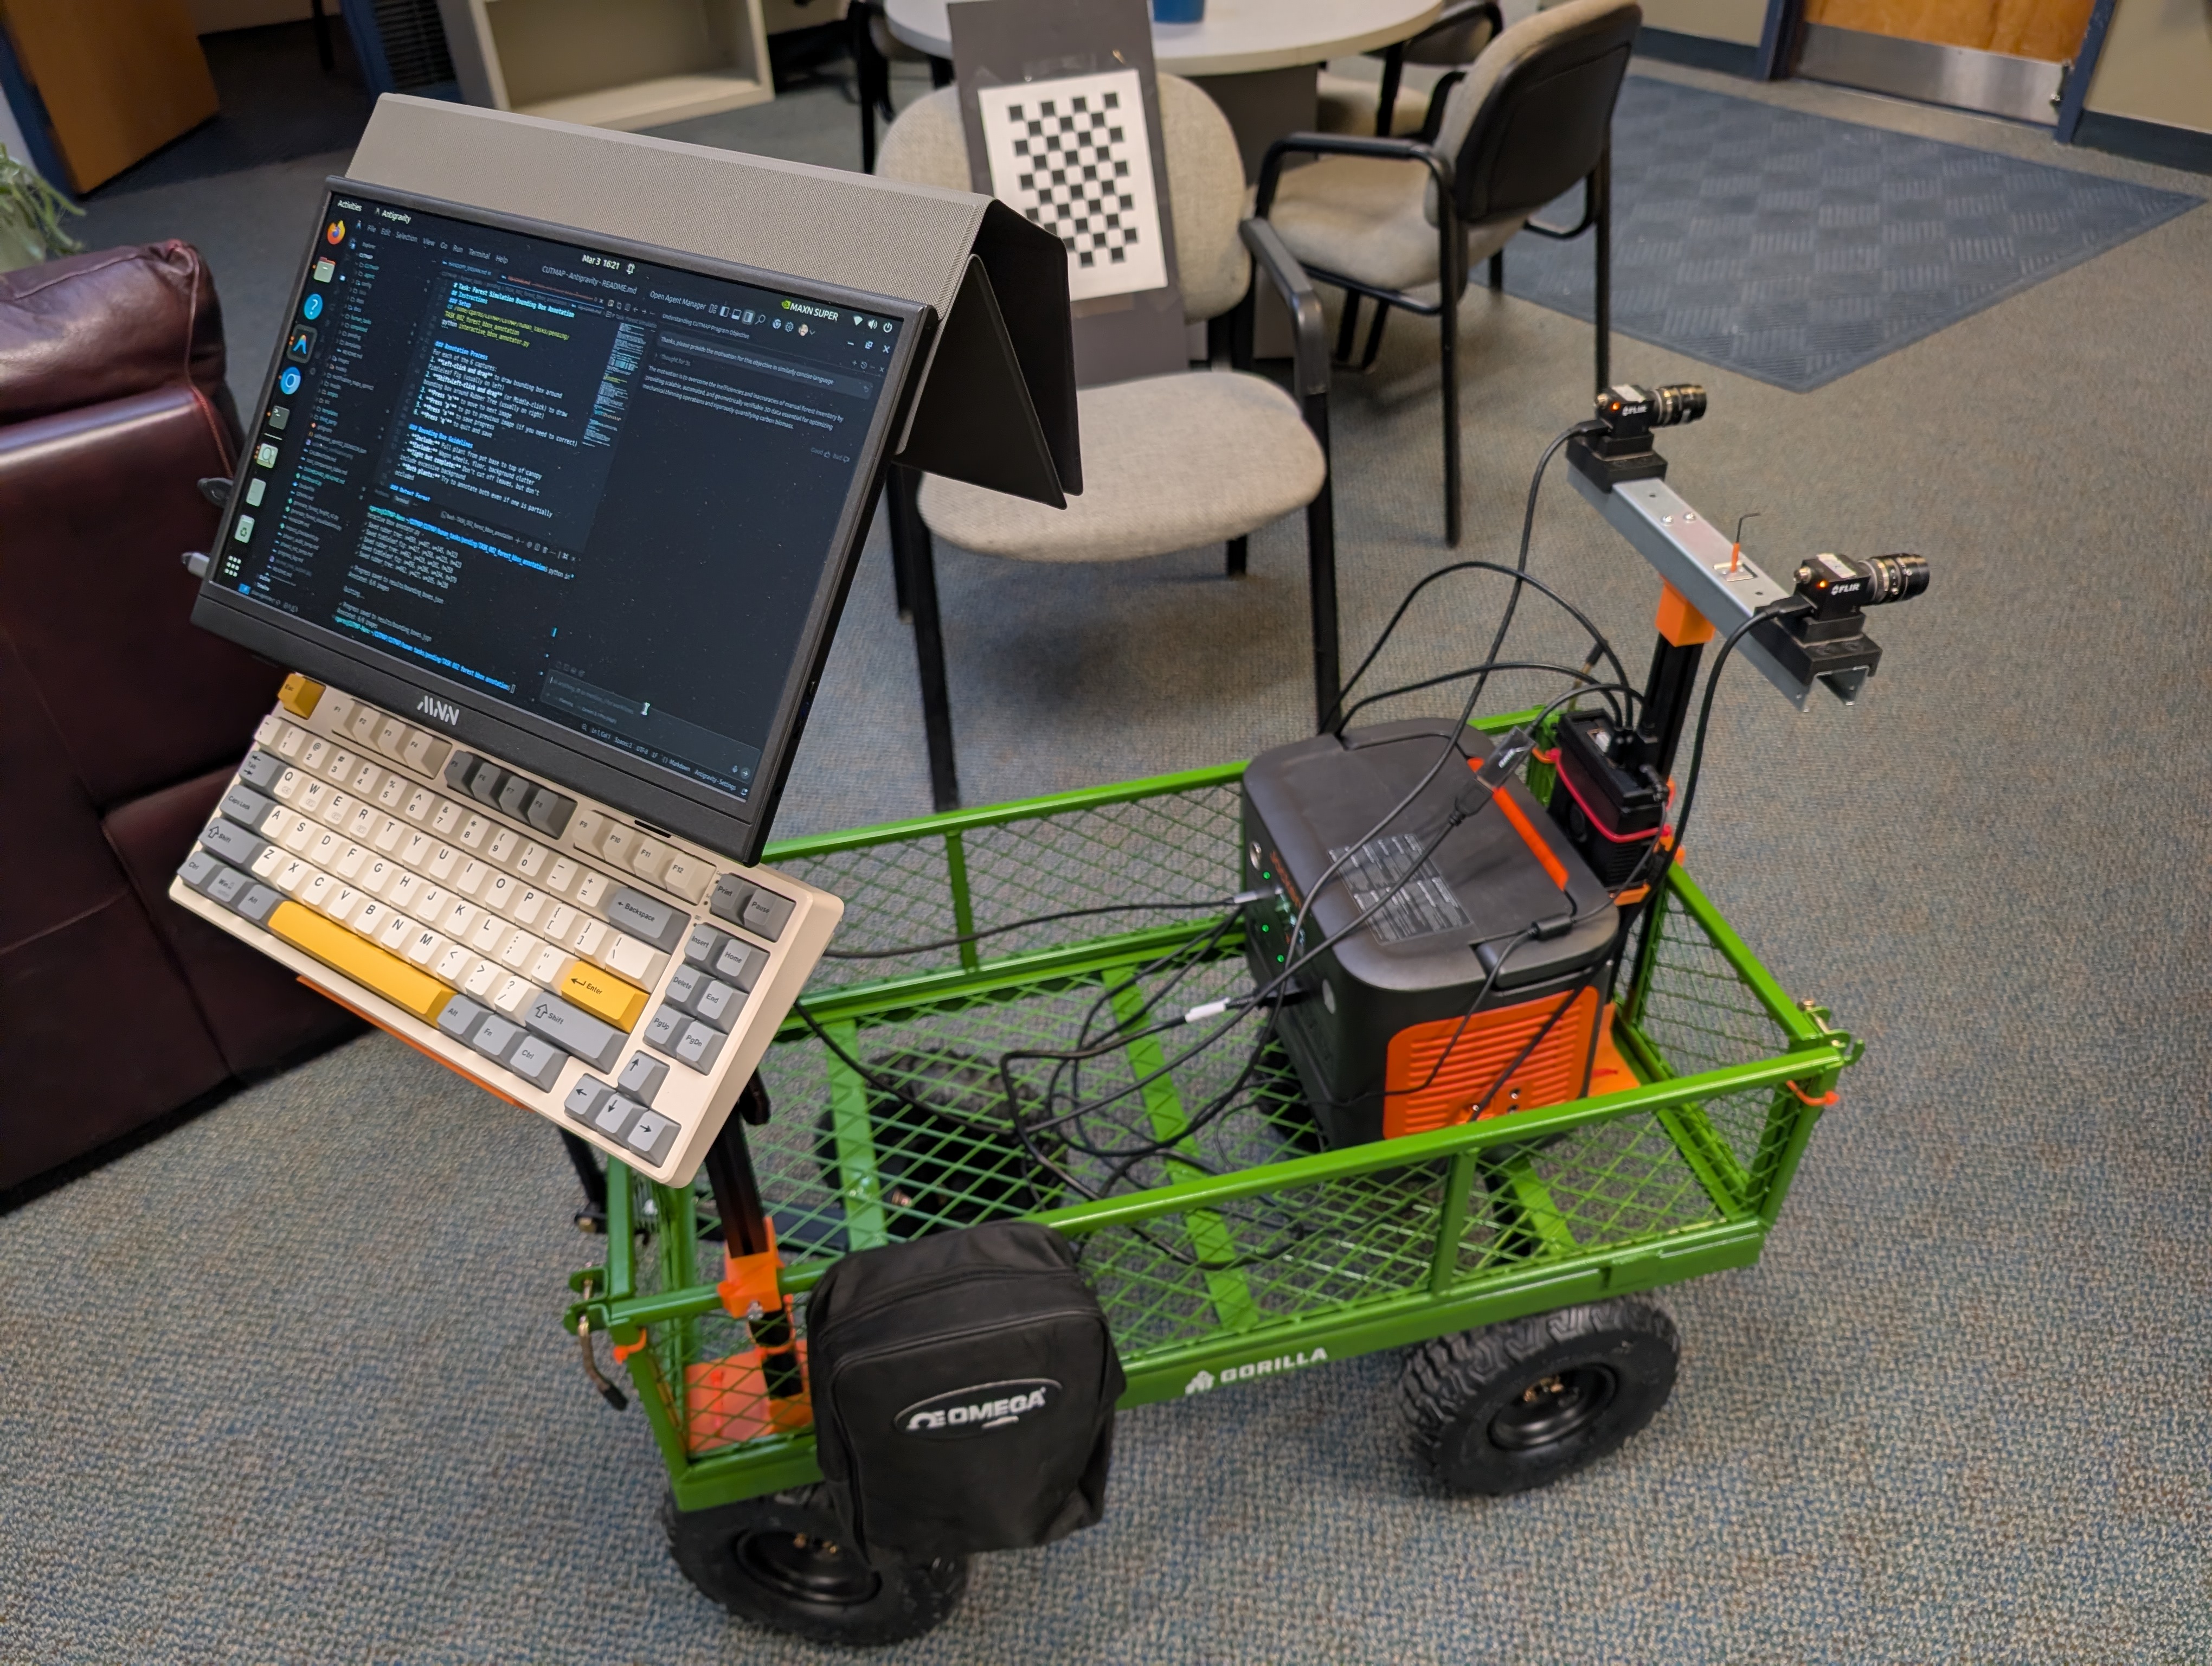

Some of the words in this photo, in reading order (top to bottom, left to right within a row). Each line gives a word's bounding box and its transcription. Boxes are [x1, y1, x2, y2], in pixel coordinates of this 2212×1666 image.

[338, 200, 362, 211] Activities
[381, 210, 411, 223] Antigravity
[395, 232, 418, 242] Selection
[468, 248, 491, 259] Terminal
[495, 255, 509, 264] Help
[582, 255, 596, 264] Mar
[602, 259, 620, 269] 16:21
[542, 266, 565, 277] CUTMAP
[568, 273, 599, 286] Antigravity
[602, 280, 637, 294] README.md
[472, 287, 488, 296] Forest
[488, 291, 515, 302] Simulation
[649, 291, 665, 301] Open
[665, 295, 681, 305] Agent
[681, 299, 706, 311] Manager
[790, 304, 813, 314] MAXN
[814, 309, 838, 321] SUPER
[555, 435, 577, 447] correct)
[528, 505, 552, 517] partially
[1838, 582, 1861, 593] FLIR
[285, 772, 293, 781] Q
[309, 783, 320, 794] W
[228, 795, 240, 804] Caps
[333, 796, 343, 806] E
[272, 810, 281, 821] A
[358, 809, 368, 819] R
[297, 822, 306, 832] S
[386, 822, 395, 832] T
[218, 832, 232, 844] Shift
[321, 836, 331, 845] D
[413, 835, 422, 846] Y
[610, 835, 621, 844] F10
[263, 850, 274, 859] Z
[347, 848, 357, 857] F
[439, 849, 449, 860] U
[641, 849, 651, 858] F11
[188, 861, 200, 870] Ctrl
[288, 863, 299, 873] X
[374, 863, 383, 873] G
[466, 863, 473, 873] I
[672, 864, 684, 874] F12
[314, 877, 324, 887] C
[400, 876, 411, 887] H
[496, 878, 506, 889] O
[341, 890, 351, 900] V
[427, 892, 437, 901] J
[718, 885, 734, 897] Print
[248, 895, 258, 905] Alt
[524, 892, 534, 902] P
[365, 905, 376, 915] B
[455, 905, 466, 916] K
[625, 902, 655, 922] Backspace
[751, 901, 770, 914] Pause
[392, 919, 404, 930] N
[483, 919, 491, 931] L
[420, 933, 433, 946] M
[691, 935, 709, 949] Insert
[724, 952, 743, 963] Home
[586, 983, 603, 995] Enter
[673, 977, 692, 990] Delete
[706, 993, 719, 1004] End
[448, 1008, 459, 1017] Alt
[548, 1013, 564, 1024] Shift
[654, 1017, 670, 1030] PgUp
[484, 1028, 493, 1036] Fn
[686, 1034, 703, 1047] PgDn
[522, 1049, 535, 1060] Ctrl
[1220, 1347, 1328, 1383] GORILLA
